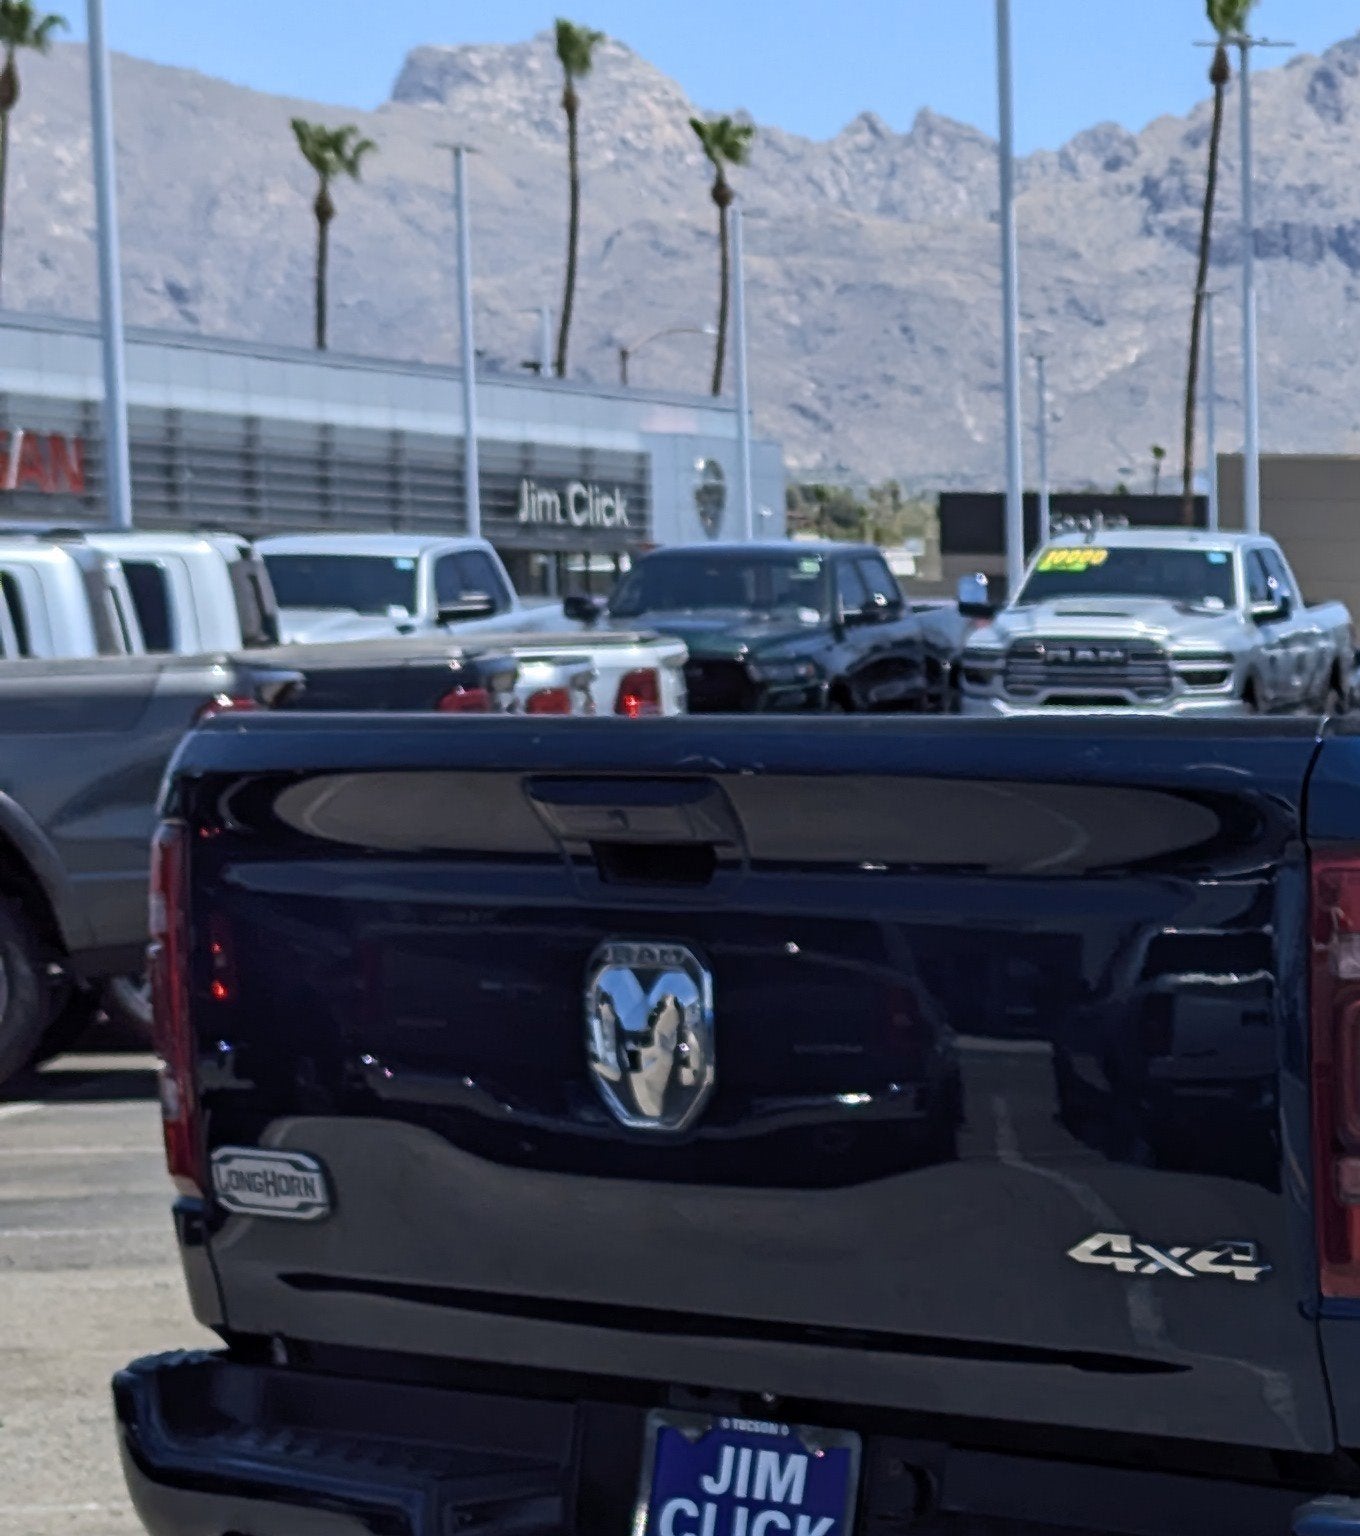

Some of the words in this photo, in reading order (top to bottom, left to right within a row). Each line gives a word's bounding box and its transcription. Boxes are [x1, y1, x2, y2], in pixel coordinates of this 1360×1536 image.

[518, 478, 562, 523] Jim
[565, 480, 630, 527] Click
[702, 1445, 808, 1505] JIM
